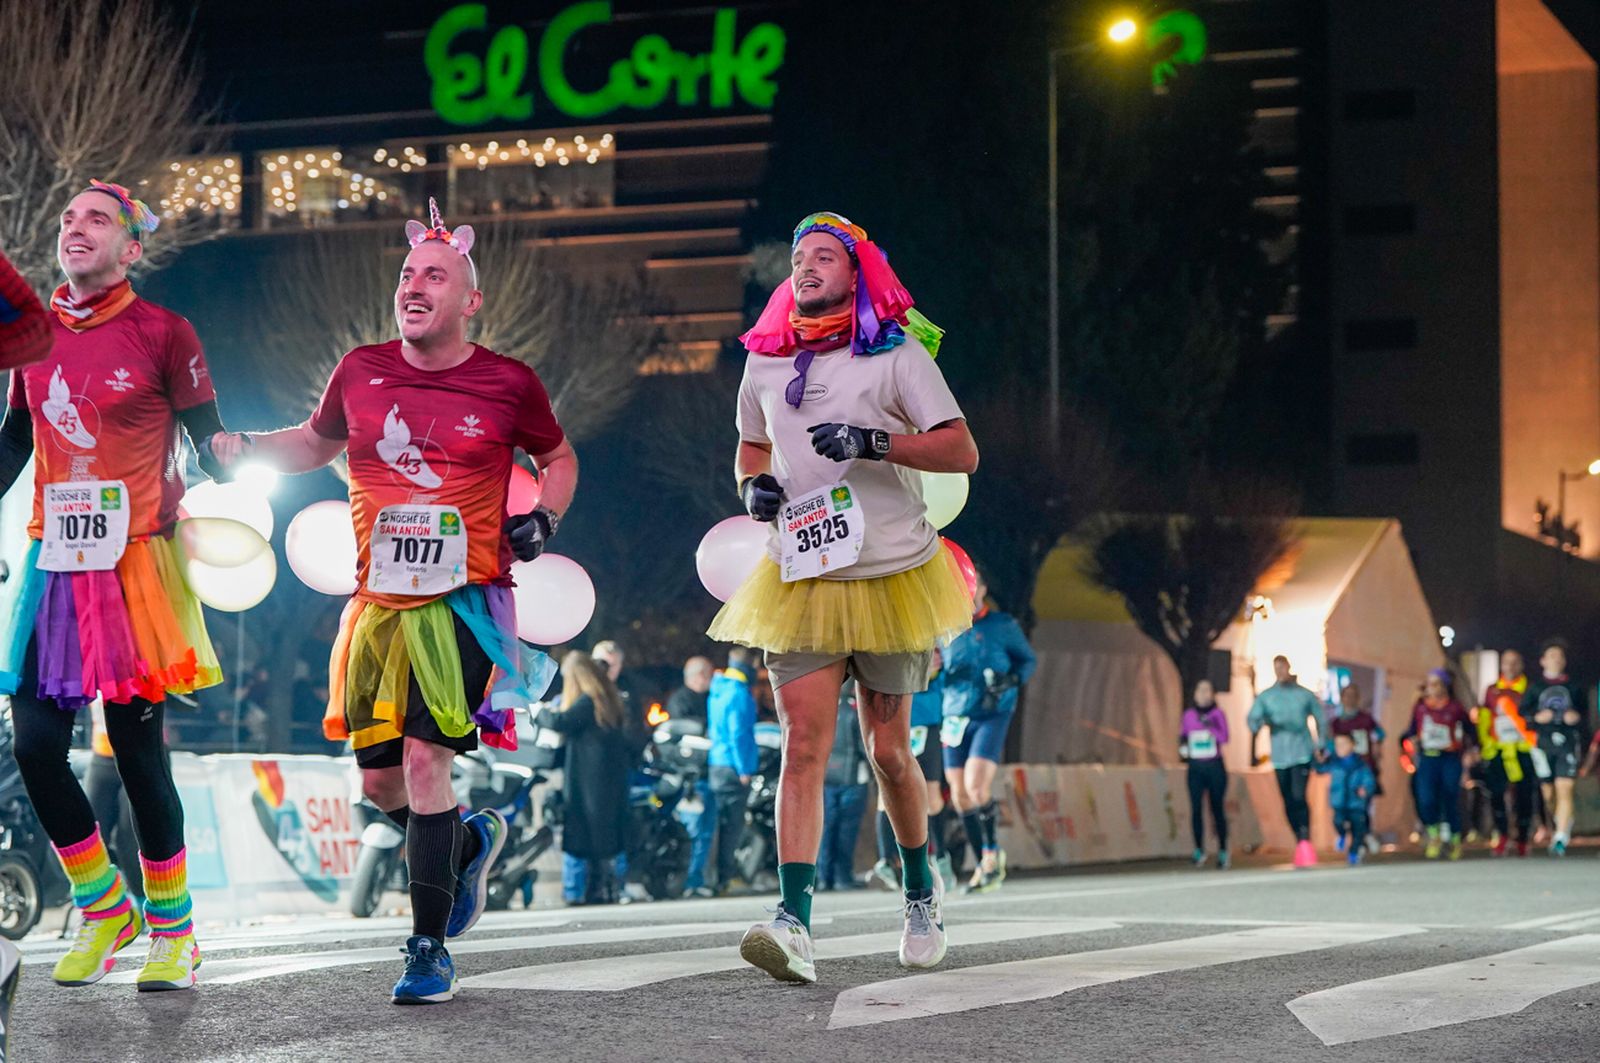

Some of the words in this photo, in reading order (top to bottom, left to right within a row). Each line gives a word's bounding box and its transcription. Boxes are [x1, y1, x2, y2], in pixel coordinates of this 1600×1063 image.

[423, 3, 533, 126] El
[538, 1, 787, 118] Corte
[58, 411, 78, 434] 43
[396, 452, 421, 475] 43
[793, 501, 816, 517] NOCHE
[816, 497, 825, 508] DE
[379, 525, 397, 534] SAN
[389, 514, 418, 524] NOCHE
[419, 515, 431, 524] DE
[787, 518, 803, 532] SAN
[796, 513, 849, 553] 3525
[391, 537, 444, 564] 7077
[306, 797, 351, 833] SAN
[320, 837, 360, 876] ANT
